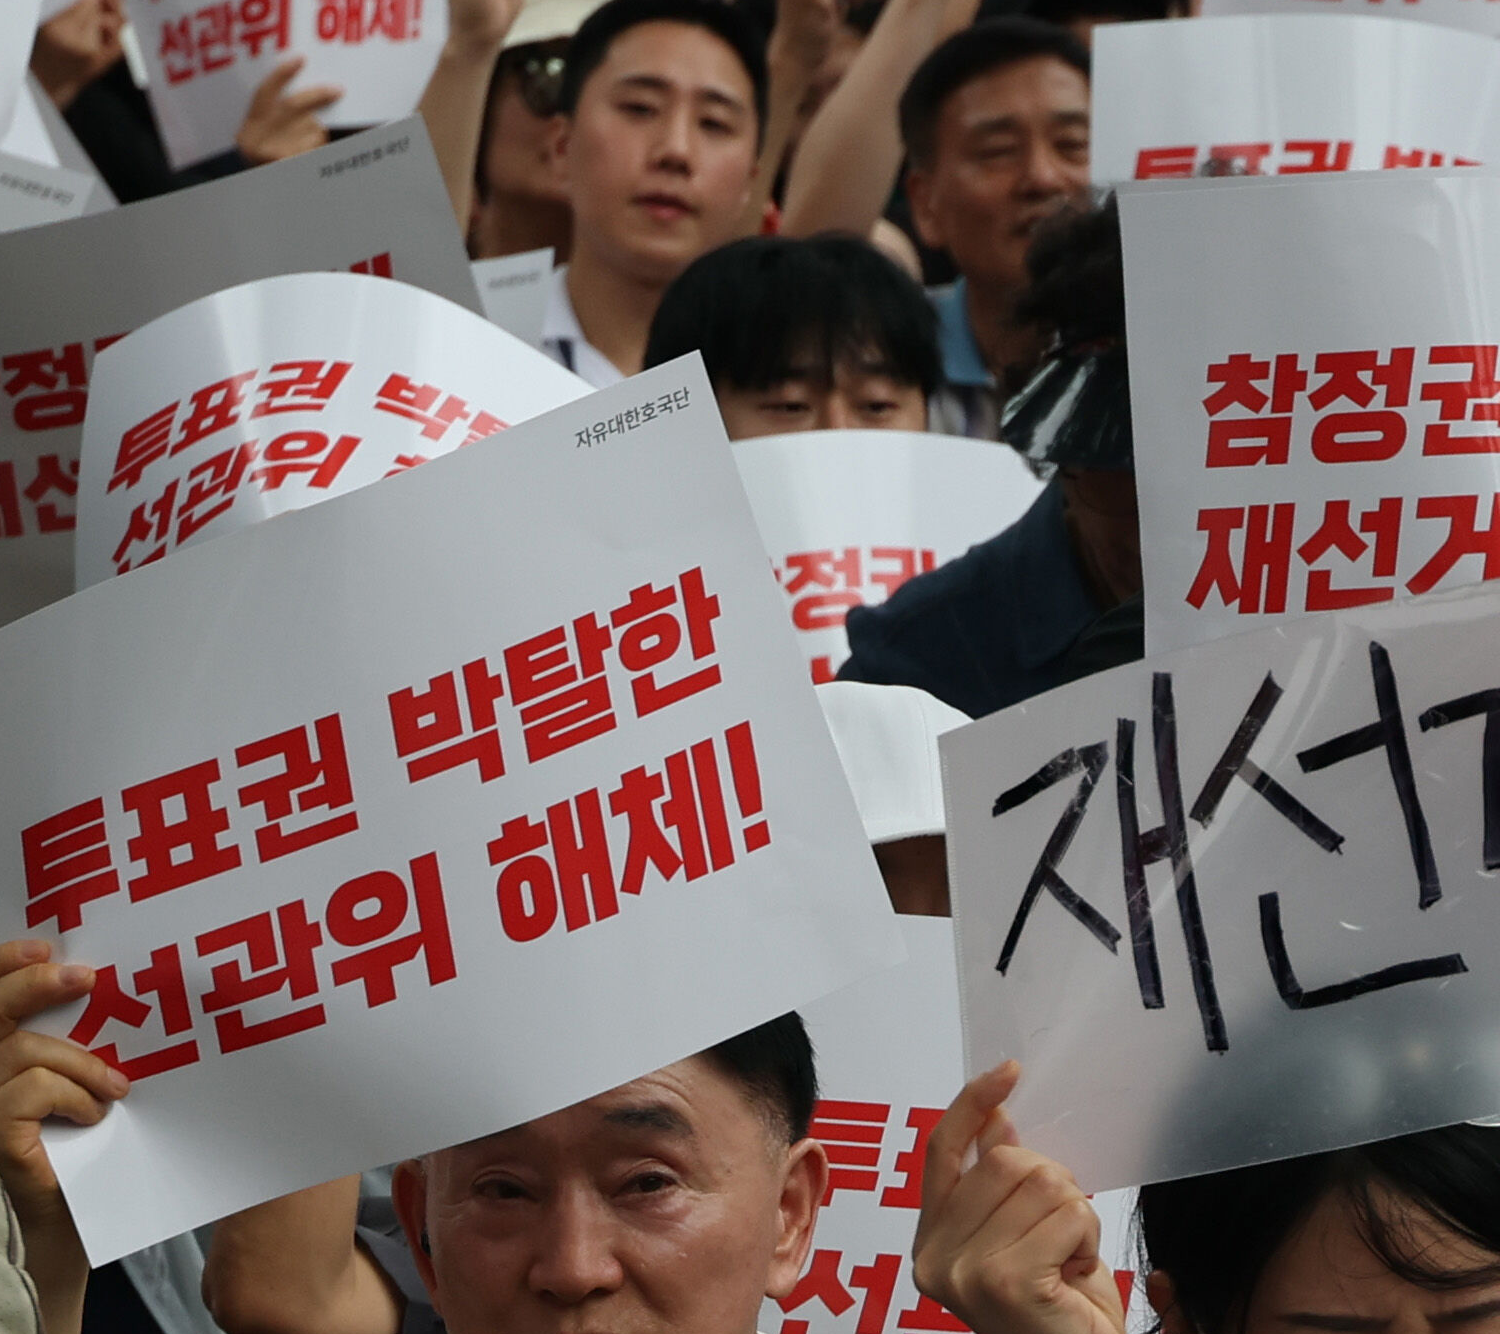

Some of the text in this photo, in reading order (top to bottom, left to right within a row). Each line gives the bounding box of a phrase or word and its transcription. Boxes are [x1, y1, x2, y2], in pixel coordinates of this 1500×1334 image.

[110, 361, 360, 497] 투표권
[575, 387, 689, 447] 자유대한호국단
[110, 429, 360, 572] 선관위
[23, 568, 721, 939] 투표권 박탈한
[65, 717, 770, 1083] 선관위 해체!
